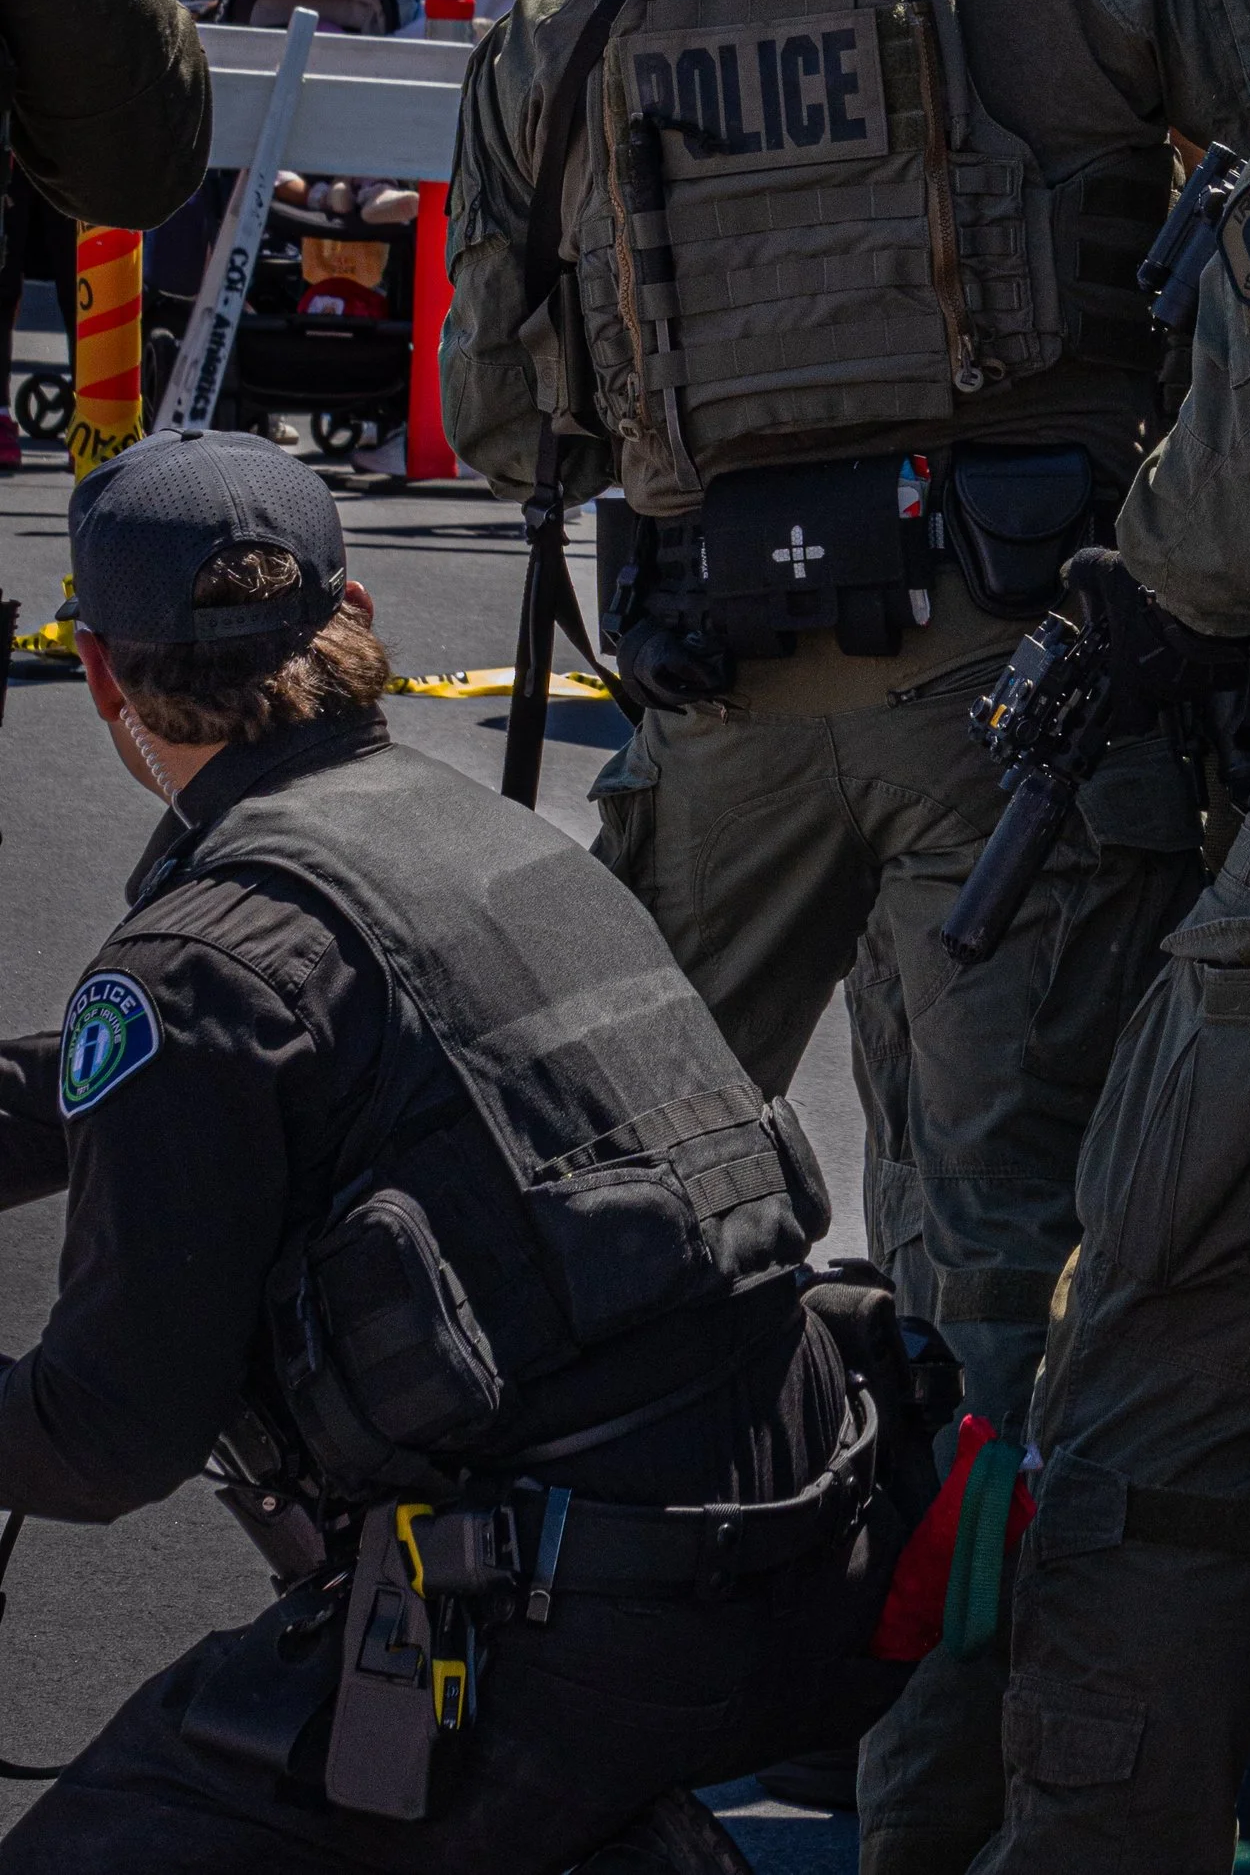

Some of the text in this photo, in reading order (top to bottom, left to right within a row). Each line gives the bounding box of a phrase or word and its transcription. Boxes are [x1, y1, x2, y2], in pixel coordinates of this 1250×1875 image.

[633, 28, 867, 161] POLICE
[69, 983, 138, 1031] POLICE
[83, 1008, 99, 1022] OF
[100, 1008, 122, 1045] IRVINE
